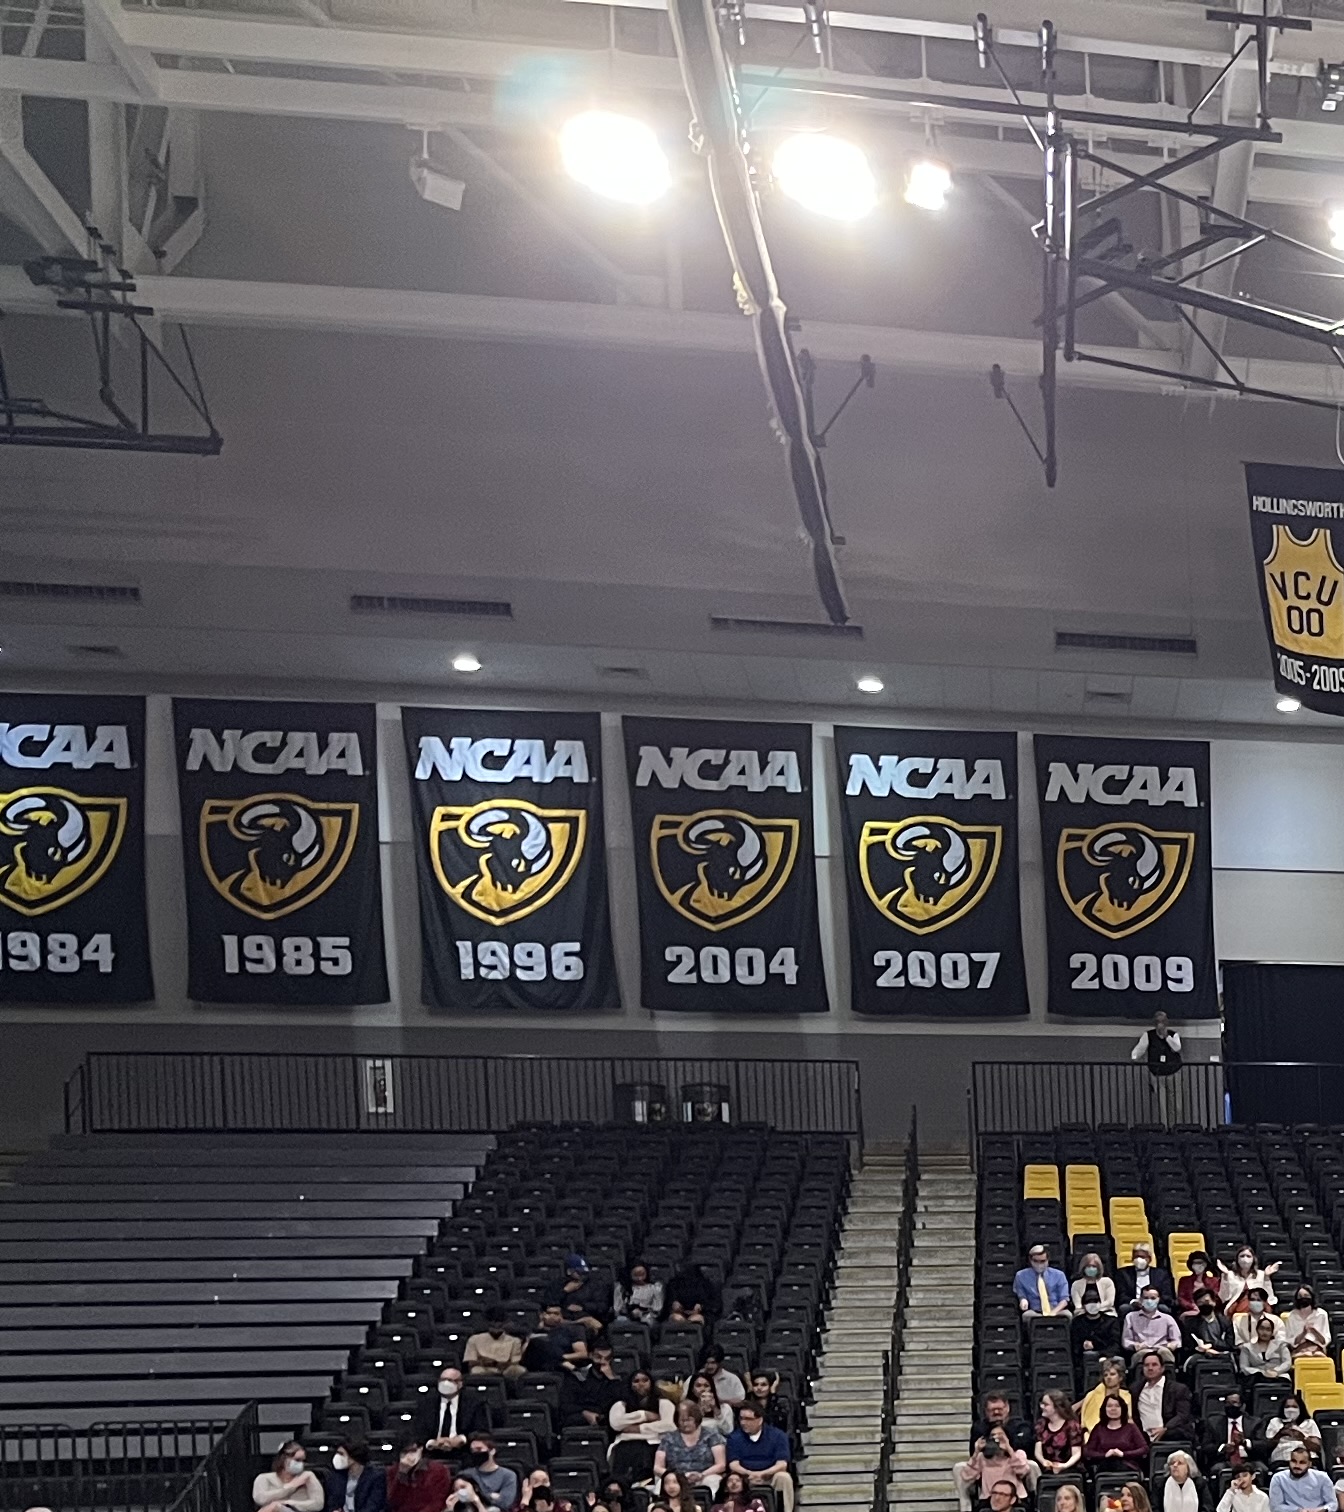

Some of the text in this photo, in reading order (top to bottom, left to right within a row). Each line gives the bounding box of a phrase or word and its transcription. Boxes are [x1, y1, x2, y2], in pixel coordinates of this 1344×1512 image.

[1269, 570, 1339, 608] VCU
[1286, 605, 1324, 637] 00
[0, 724, 131, 769] CAA
[186, 727, 364, 775] NCAA
[415, 735, 590, 783] NCAA
[636, 746, 801, 792] NCAA
[845, 754, 1007, 800] NCAA
[1045, 762, 1198, 808] NCAA
[0, 931, 115, 973] 984
[222, 934, 354, 975] 1985
[456, 940, 584, 982] 1996
[665, 946, 799, 985] 2004
[873, 950, 1001, 989] 2007
[1069, 953, 1194, 992] 2009
